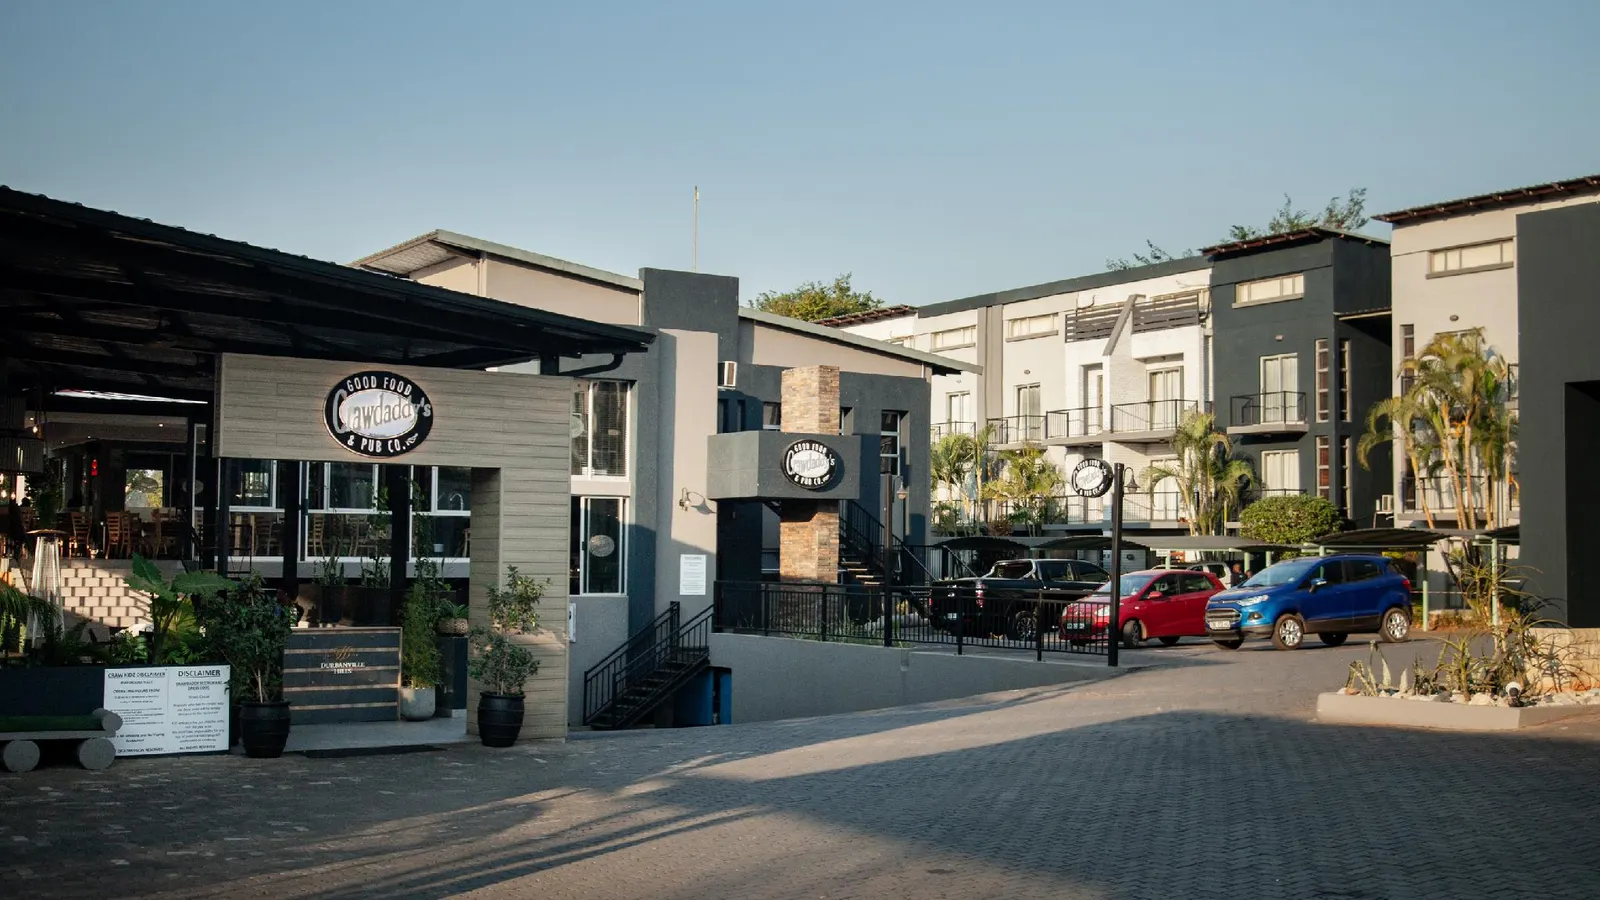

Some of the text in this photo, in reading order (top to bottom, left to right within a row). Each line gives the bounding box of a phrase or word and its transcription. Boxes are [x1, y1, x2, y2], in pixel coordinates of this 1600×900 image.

[346, 375, 412, 396] GOOD FOOD
[332, 388, 432, 434] Crawdaddy's
[347, 435, 355, 446] &
[360, 438, 383, 453] PUB
[387, 439, 407, 453] CO.
